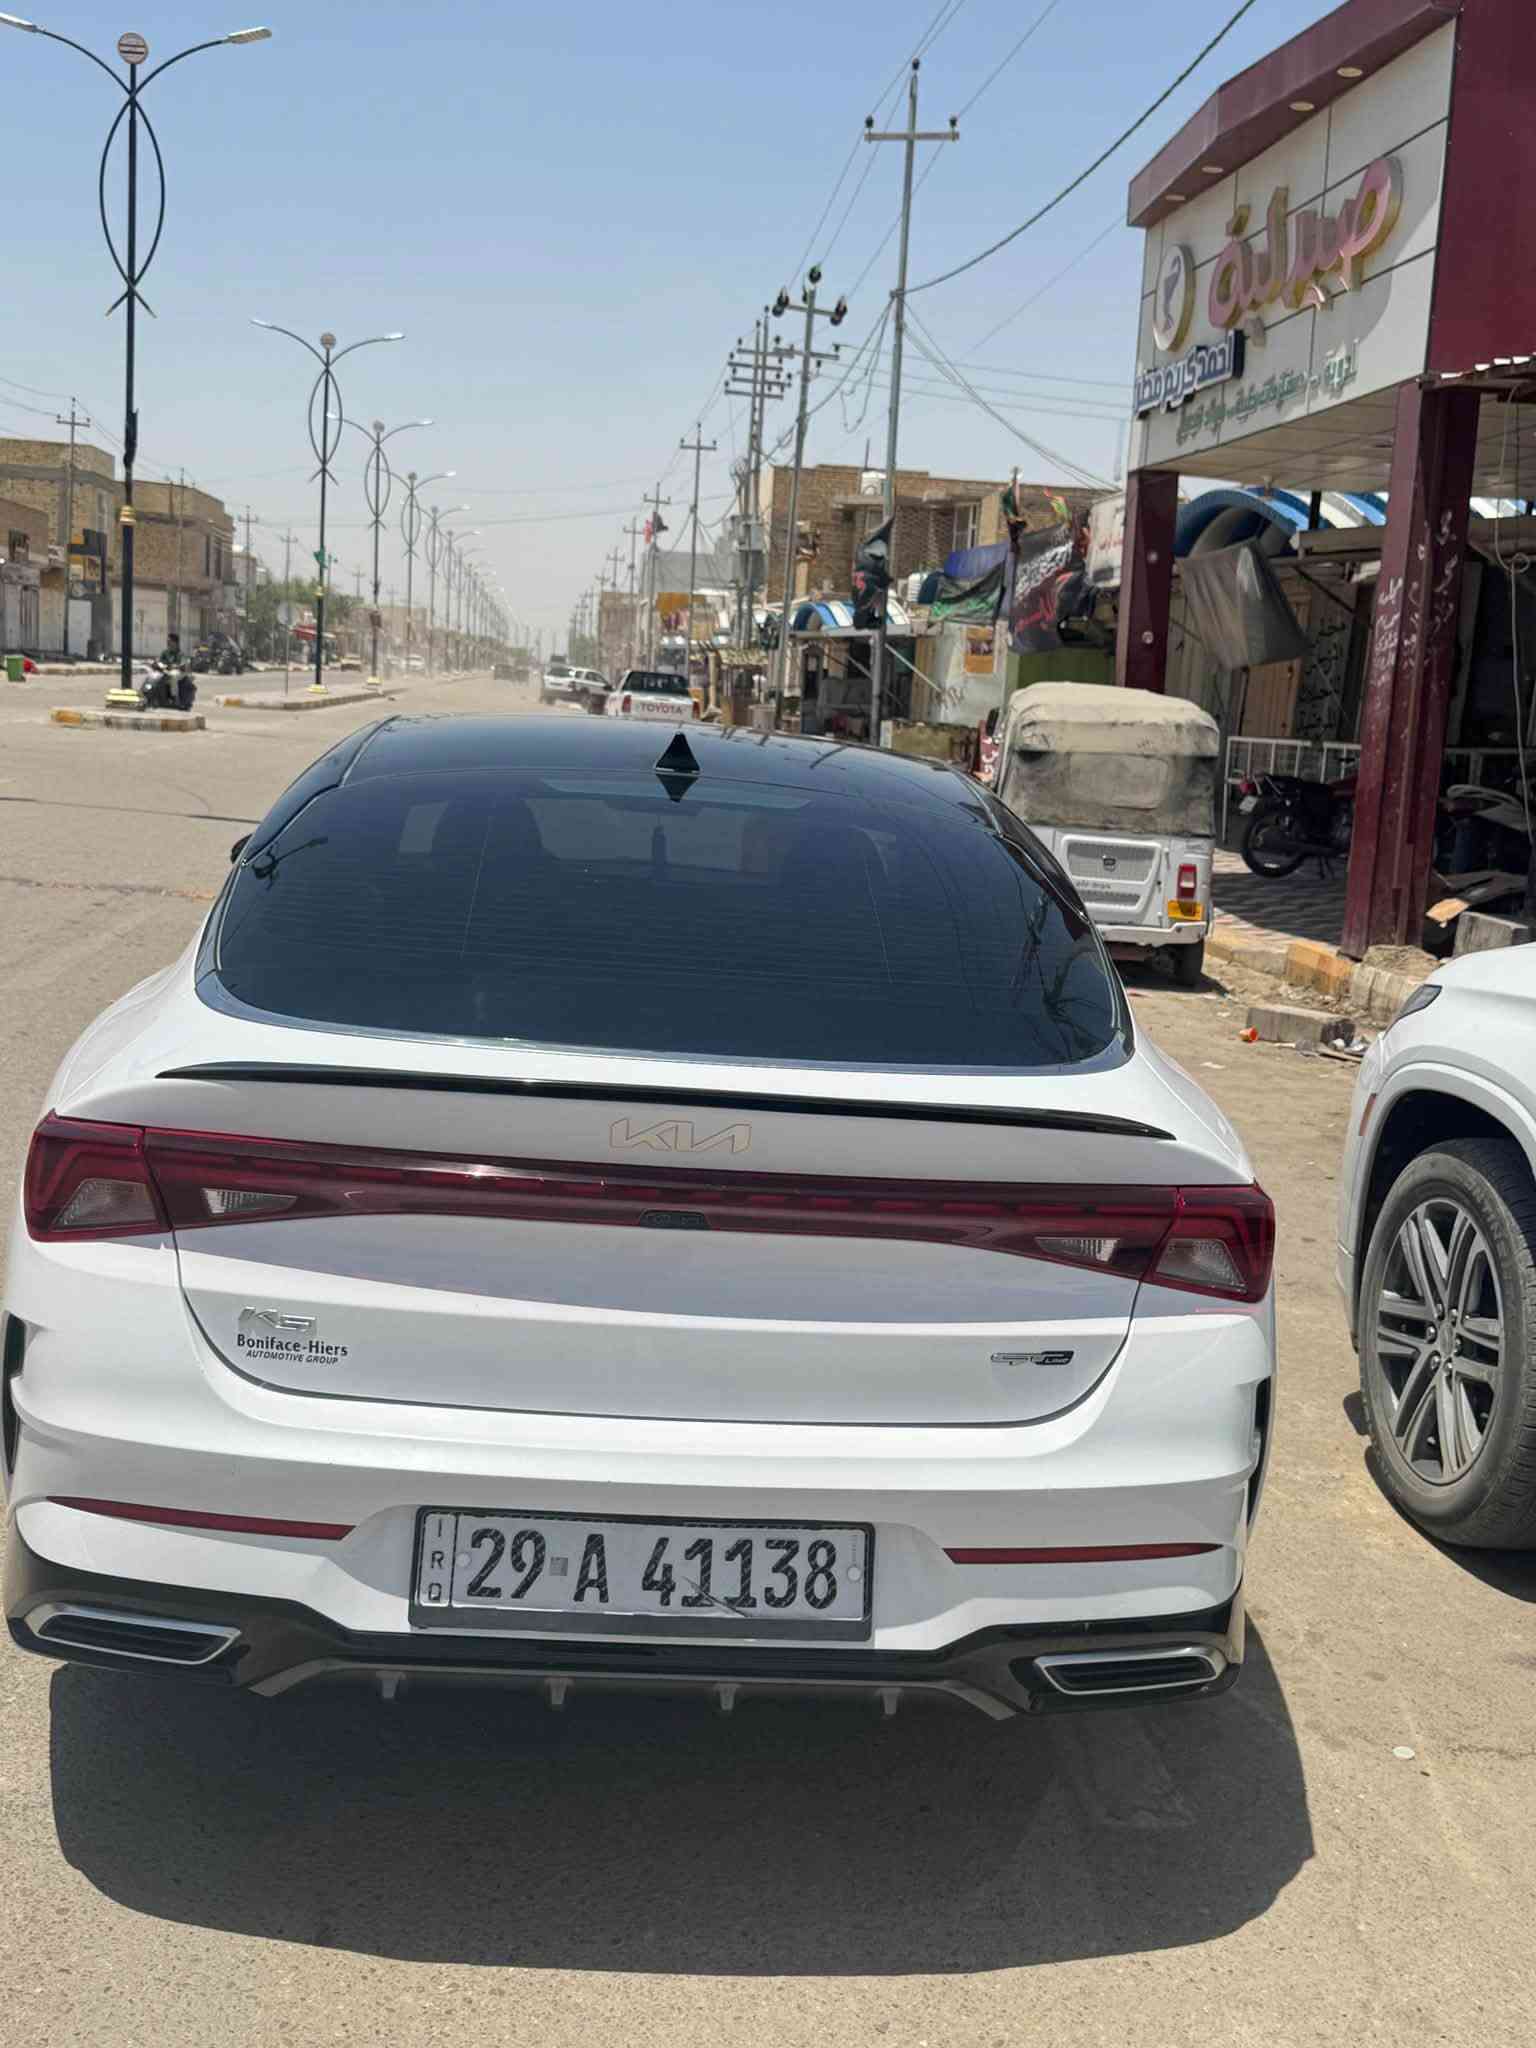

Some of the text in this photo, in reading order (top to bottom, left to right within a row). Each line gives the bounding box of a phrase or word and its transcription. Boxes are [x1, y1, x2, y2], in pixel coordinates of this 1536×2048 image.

[641, 702, 683, 715] TOYOTA
[610, 1118, 751, 1153] KIA
[236, 1333, 348, 1357] Boniface-Hiers
[245, 1349, 339, 1366] AUTOMOTIVE GROUP
[466, 1527, 838, 1610] 29 A 41138
